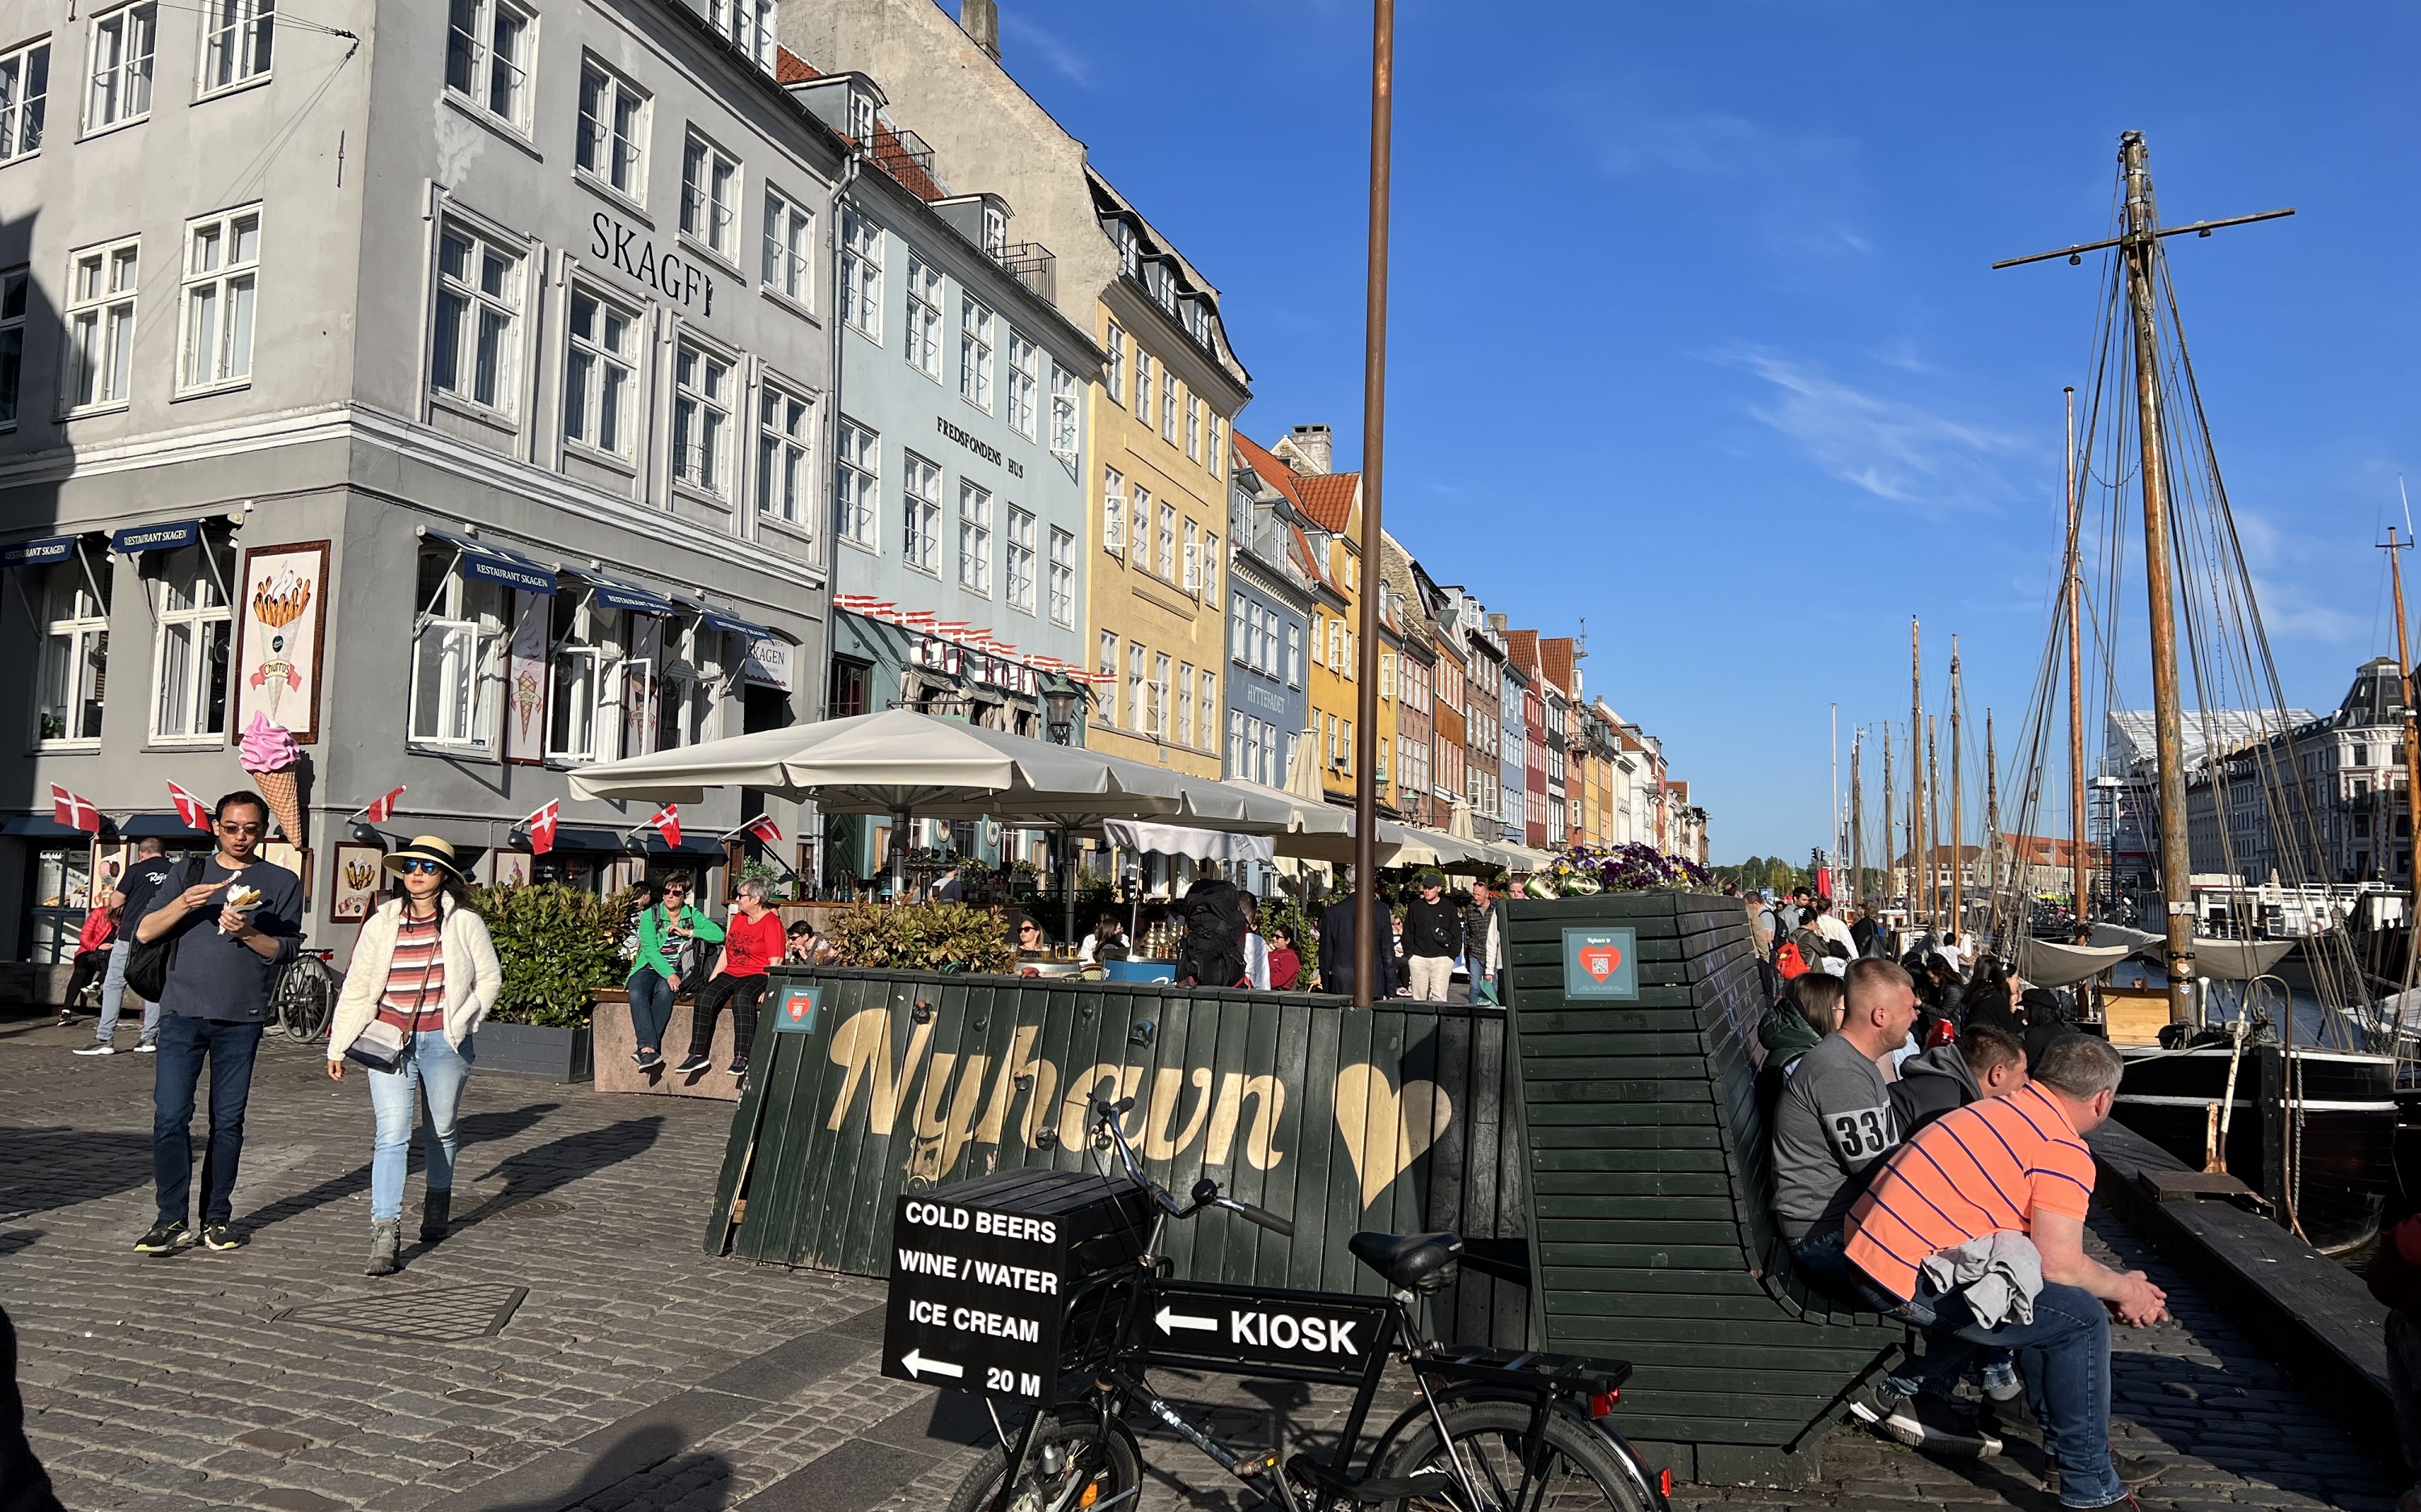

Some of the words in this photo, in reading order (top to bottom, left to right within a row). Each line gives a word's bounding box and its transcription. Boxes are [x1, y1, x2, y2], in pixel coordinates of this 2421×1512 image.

[937, 416, 1001, 466] FREDSFONDENS
[1008, 457, 1023, 478] HUS
[5, 548, 40, 560] RESTAURANT
[41, 545, 66, 555] SKAGEN
[124, 533, 161, 545] RESTAURANT
[162, 529, 187, 541] SKAGEN
[476, 563, 521, 581] RESTAURANT
[521, 574, 548, 587] SKAGEN
[264, 662, 290, 675] Churros
[747, 645, 785, 665] SKAGEN
[912, 637, 967, 676] CAP
[980, 655, 1039, 697] HORN
[1248, 683, 1285, 715] HYTTEFADET
[827, 1008, 1286, 1181] Nyhavn
[905, 1201, 969, 1230] COLD
[976, 1211, 1056, 1243] BEERS
[898, 1247, 958, 1278] WINE
[974, 1260, 1058, 1295] WATER
[909, 1299, 948, 1327] ICE
[953, 1307, 1041, 1343] CREAM
[1231, 1310, 1358, 1355] KIOSK
[986, 1367, 1014, 1393] 20
[1021, 1372, 1041, 1398] M
